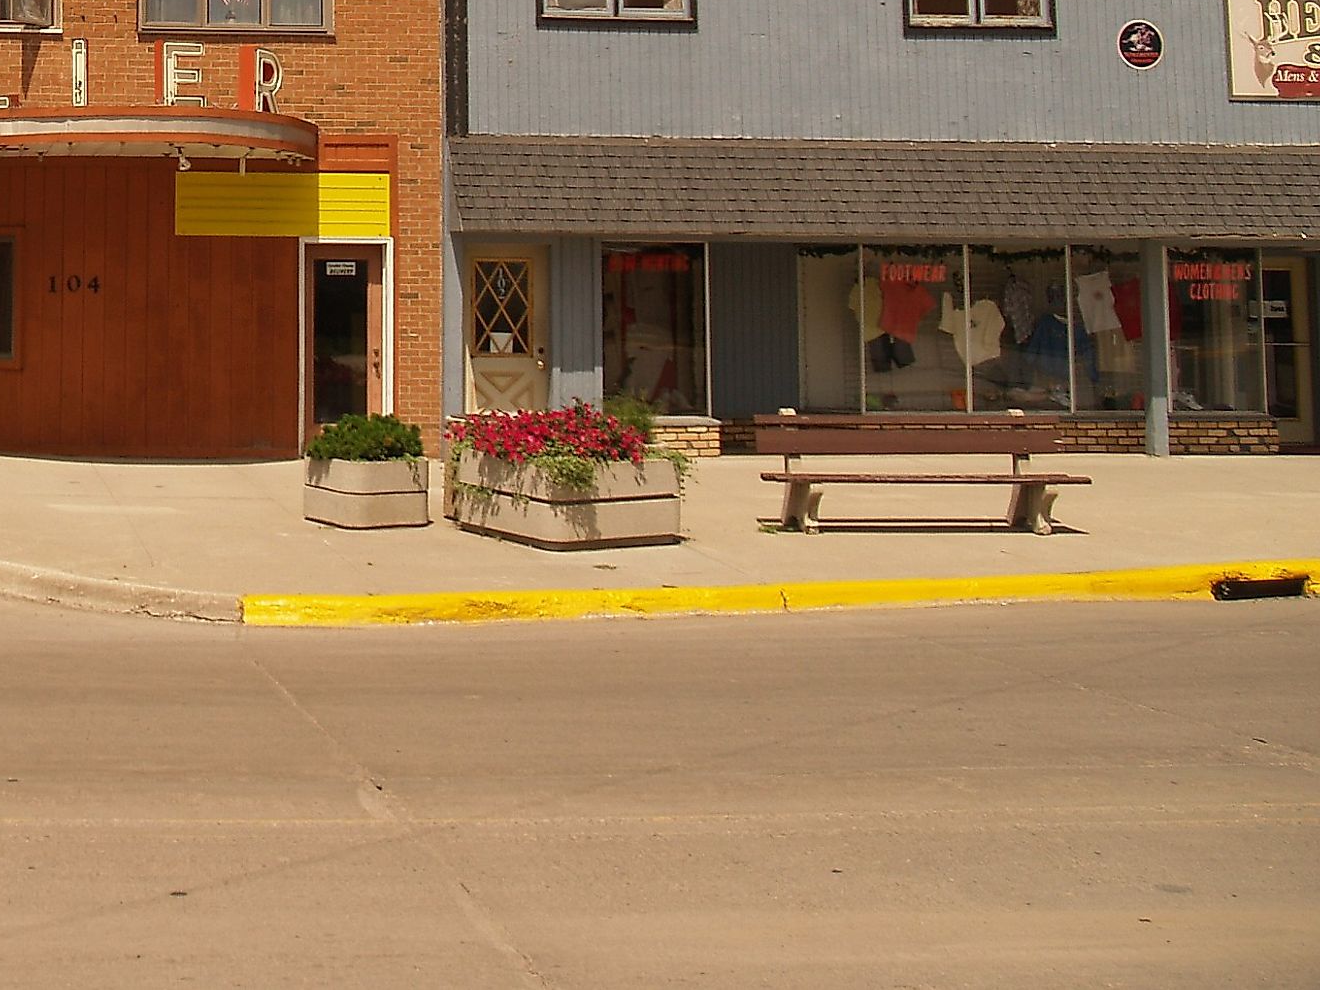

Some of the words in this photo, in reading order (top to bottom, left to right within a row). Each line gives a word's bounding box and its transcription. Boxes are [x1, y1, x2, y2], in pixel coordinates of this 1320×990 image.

[1276, 70, 1305, 83] Mens
[881, 264, 947, 282] FOOTWEAR
[48, 274, 101, 295] 104
[1189, 283, 1240, 300] CLOTHING
